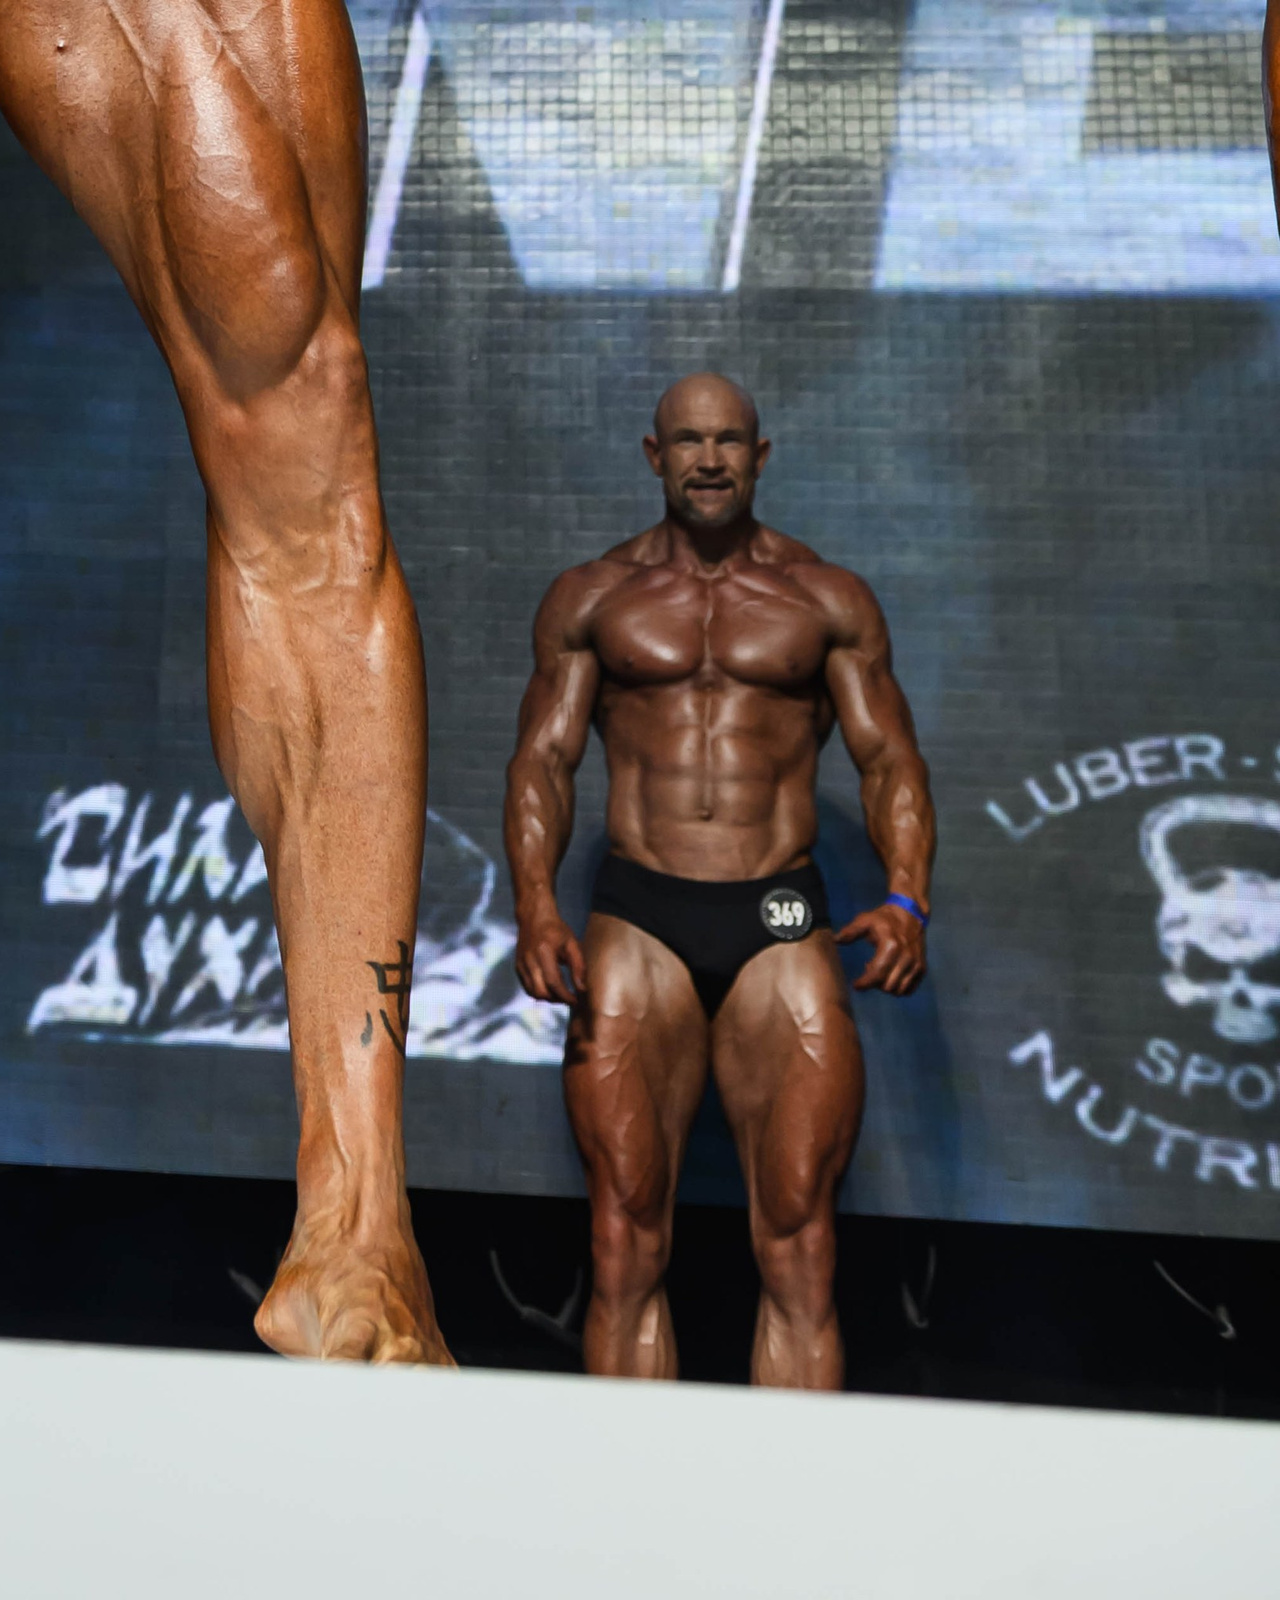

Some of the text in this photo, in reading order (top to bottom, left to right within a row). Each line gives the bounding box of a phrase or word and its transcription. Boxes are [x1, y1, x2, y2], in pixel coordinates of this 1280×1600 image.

[768, 900, 806, 927] 369
[26, 911, 284, 1035] ДУХ
[1135, 1036, 1280, 1111] SPO
